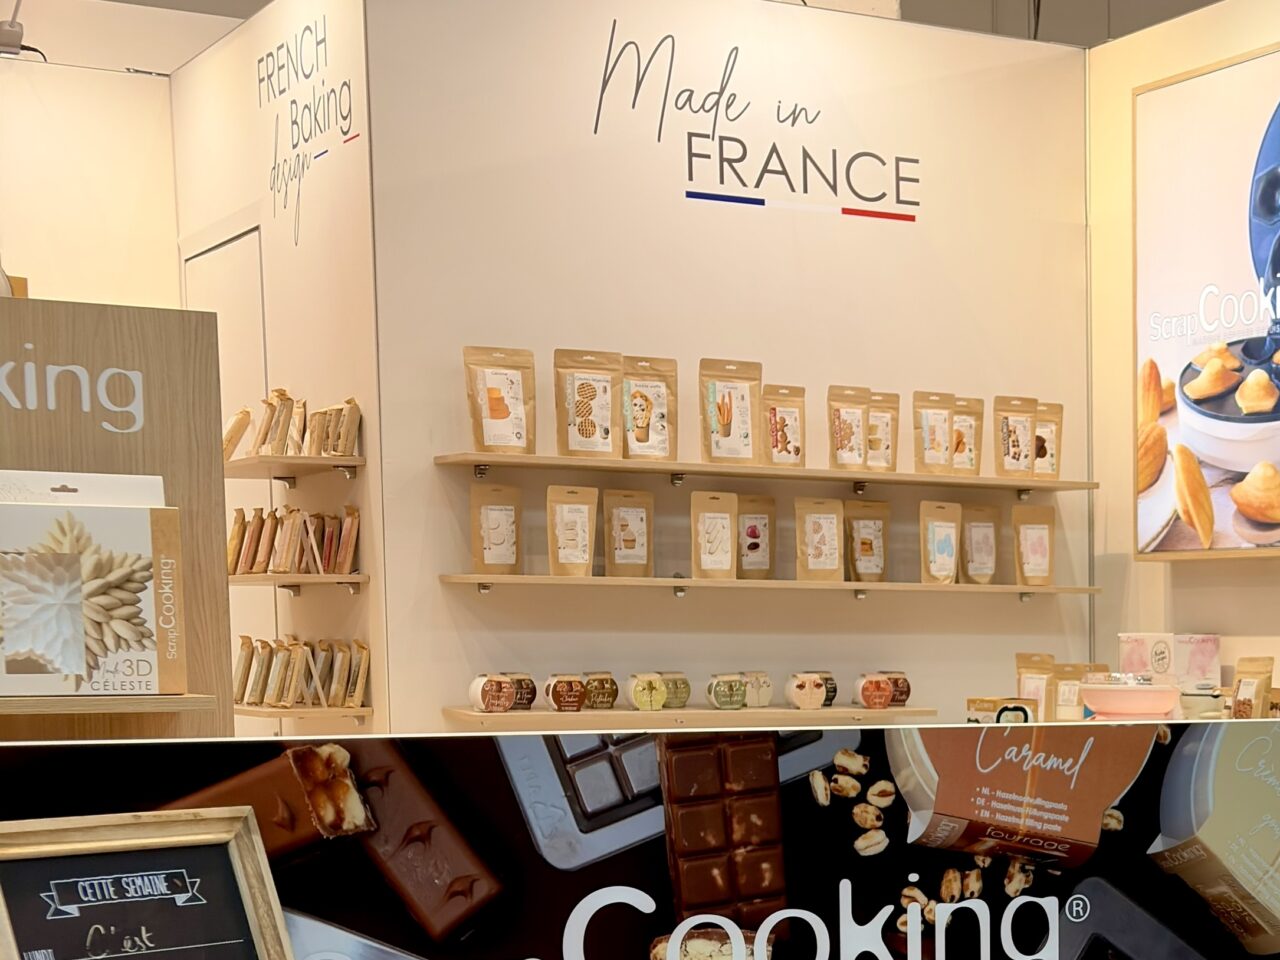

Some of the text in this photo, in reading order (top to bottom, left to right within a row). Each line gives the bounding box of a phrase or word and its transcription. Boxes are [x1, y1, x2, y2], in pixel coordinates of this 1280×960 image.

[256, 14, 328, 108] FRENCH
[594, 18, 821, 142] Made in
[290, 76, 353, 150] Baking
[269, 113, 312, 246] design
[686, 131, 920, 206] FRANCE
[90, 680, 152, 691] CÉLESTE
[122, 659, 152, 677] 3D
[976, 727, 1094, 790] Caramel
[986, 826, 1070, 852] fourrage
[77, 875, 170, 901] CETTE SEMAINE
[86, 923, 156, 959] C'est
